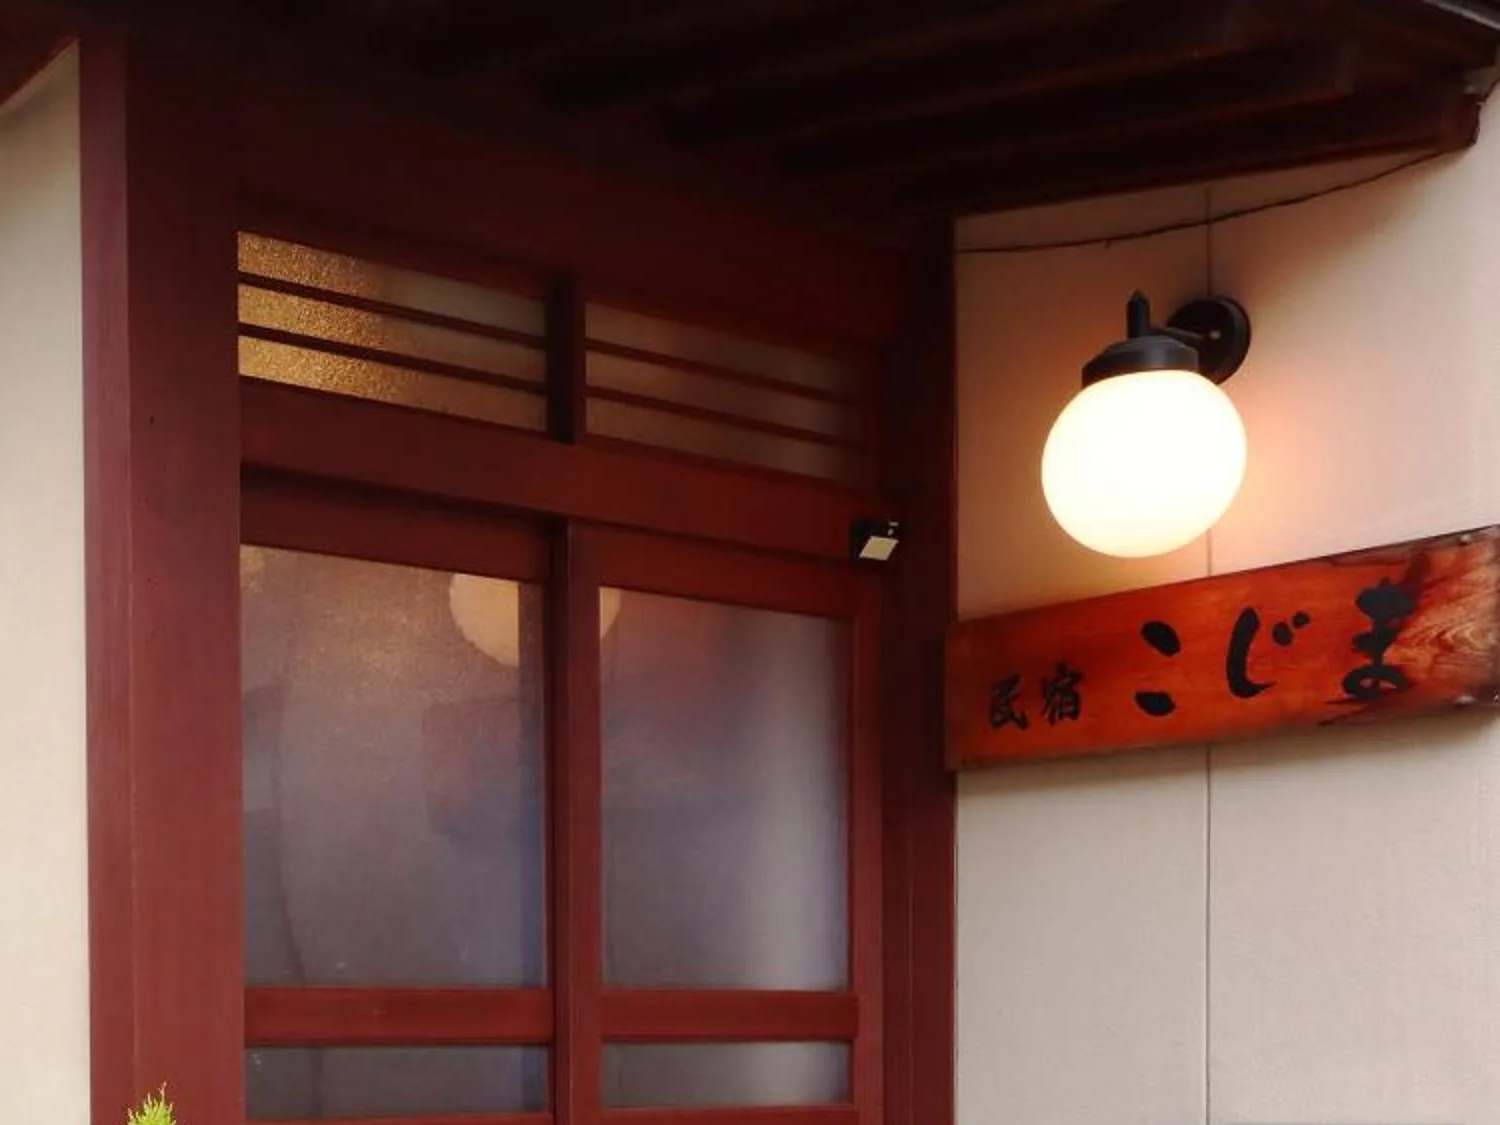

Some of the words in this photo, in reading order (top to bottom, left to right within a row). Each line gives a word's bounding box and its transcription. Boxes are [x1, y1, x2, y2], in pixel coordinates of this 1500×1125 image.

[988, 657, 1084, 731] 民宿
[1134, 578, 1417, 718] こじま
